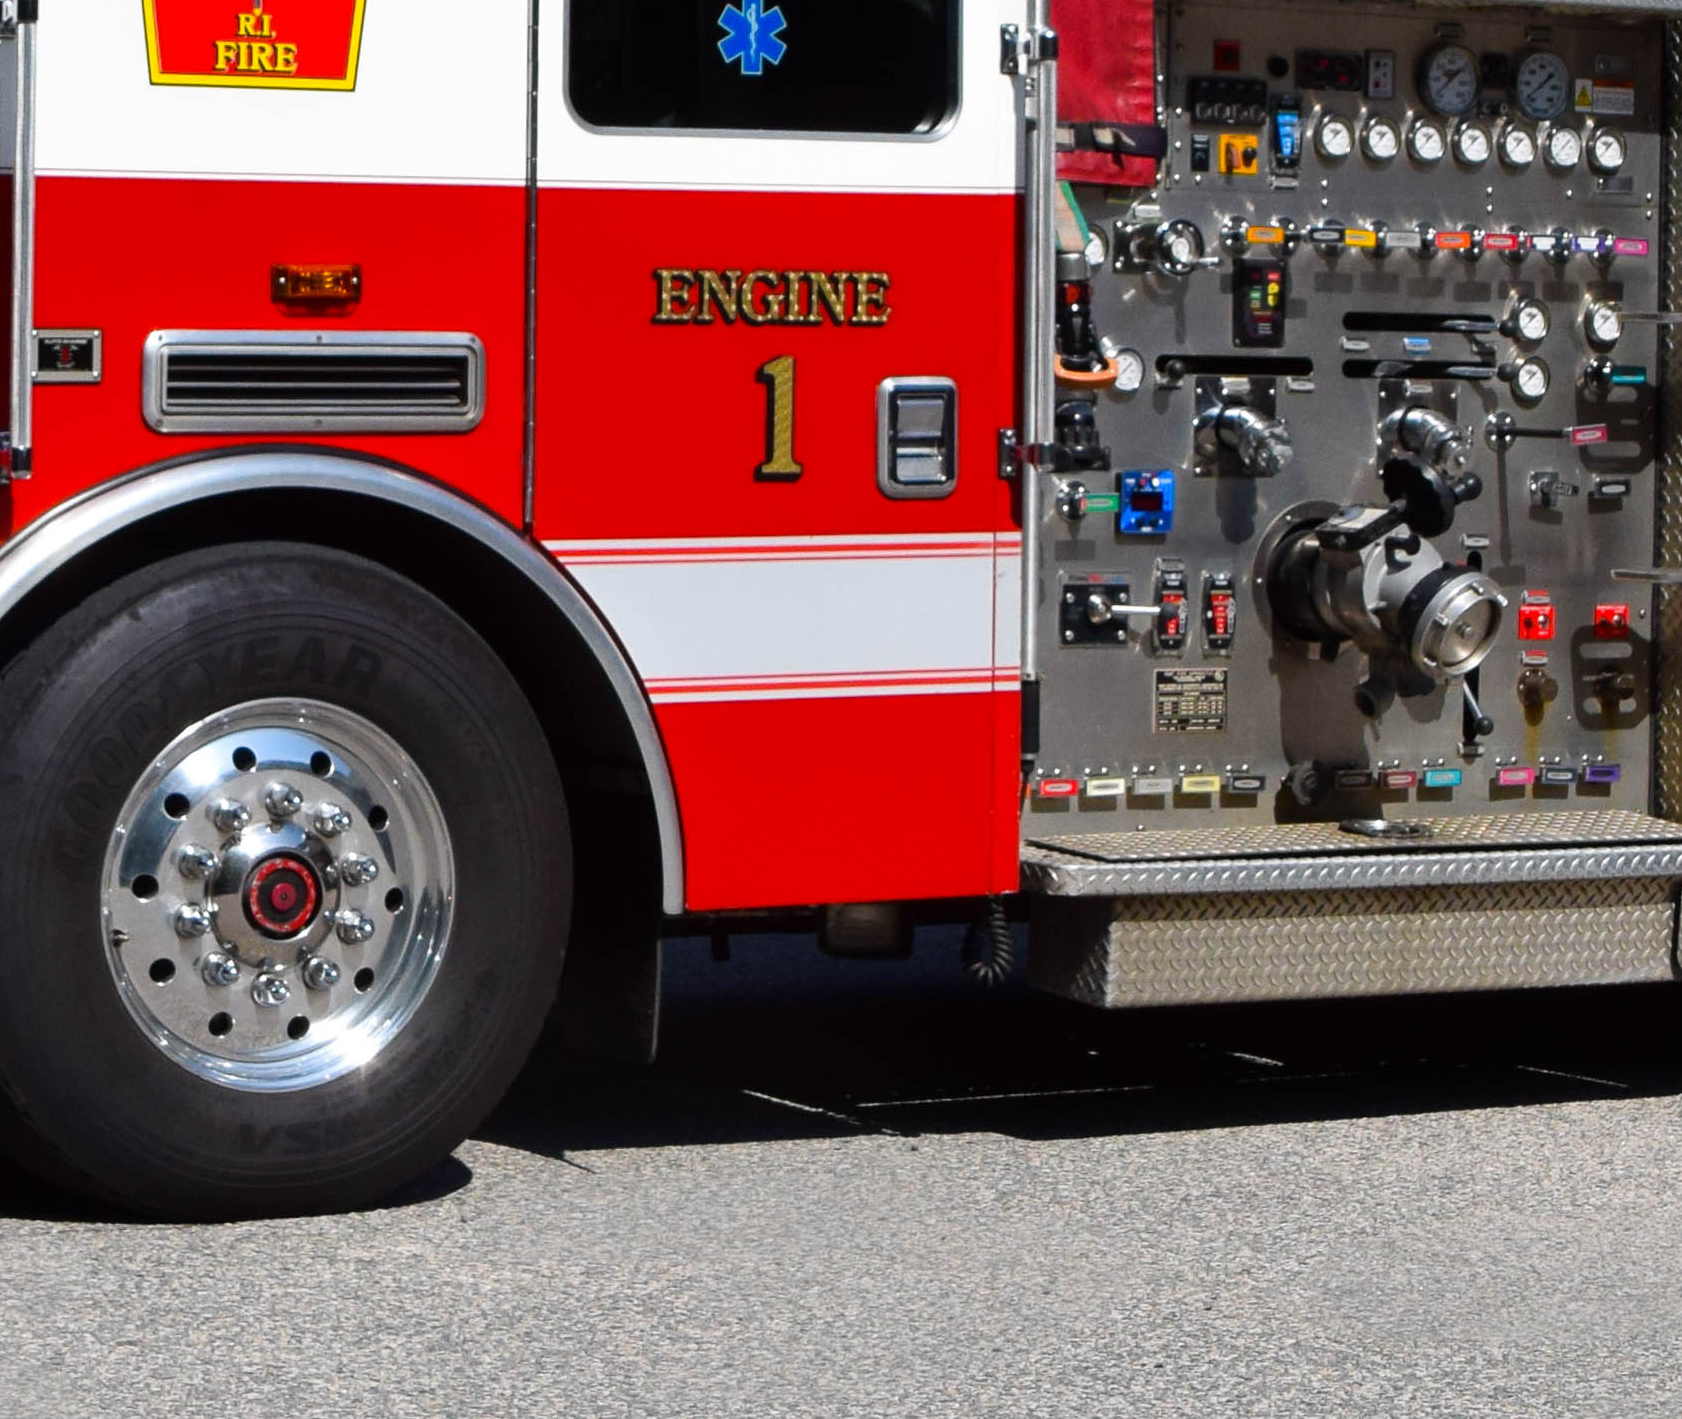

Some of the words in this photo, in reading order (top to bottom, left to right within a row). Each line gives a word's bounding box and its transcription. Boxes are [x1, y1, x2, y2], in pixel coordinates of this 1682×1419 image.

[213, 40, 299, 75] FIRE
[651, 268, 893, 326] ENGINE
[753, 354, 804, 483] 1
